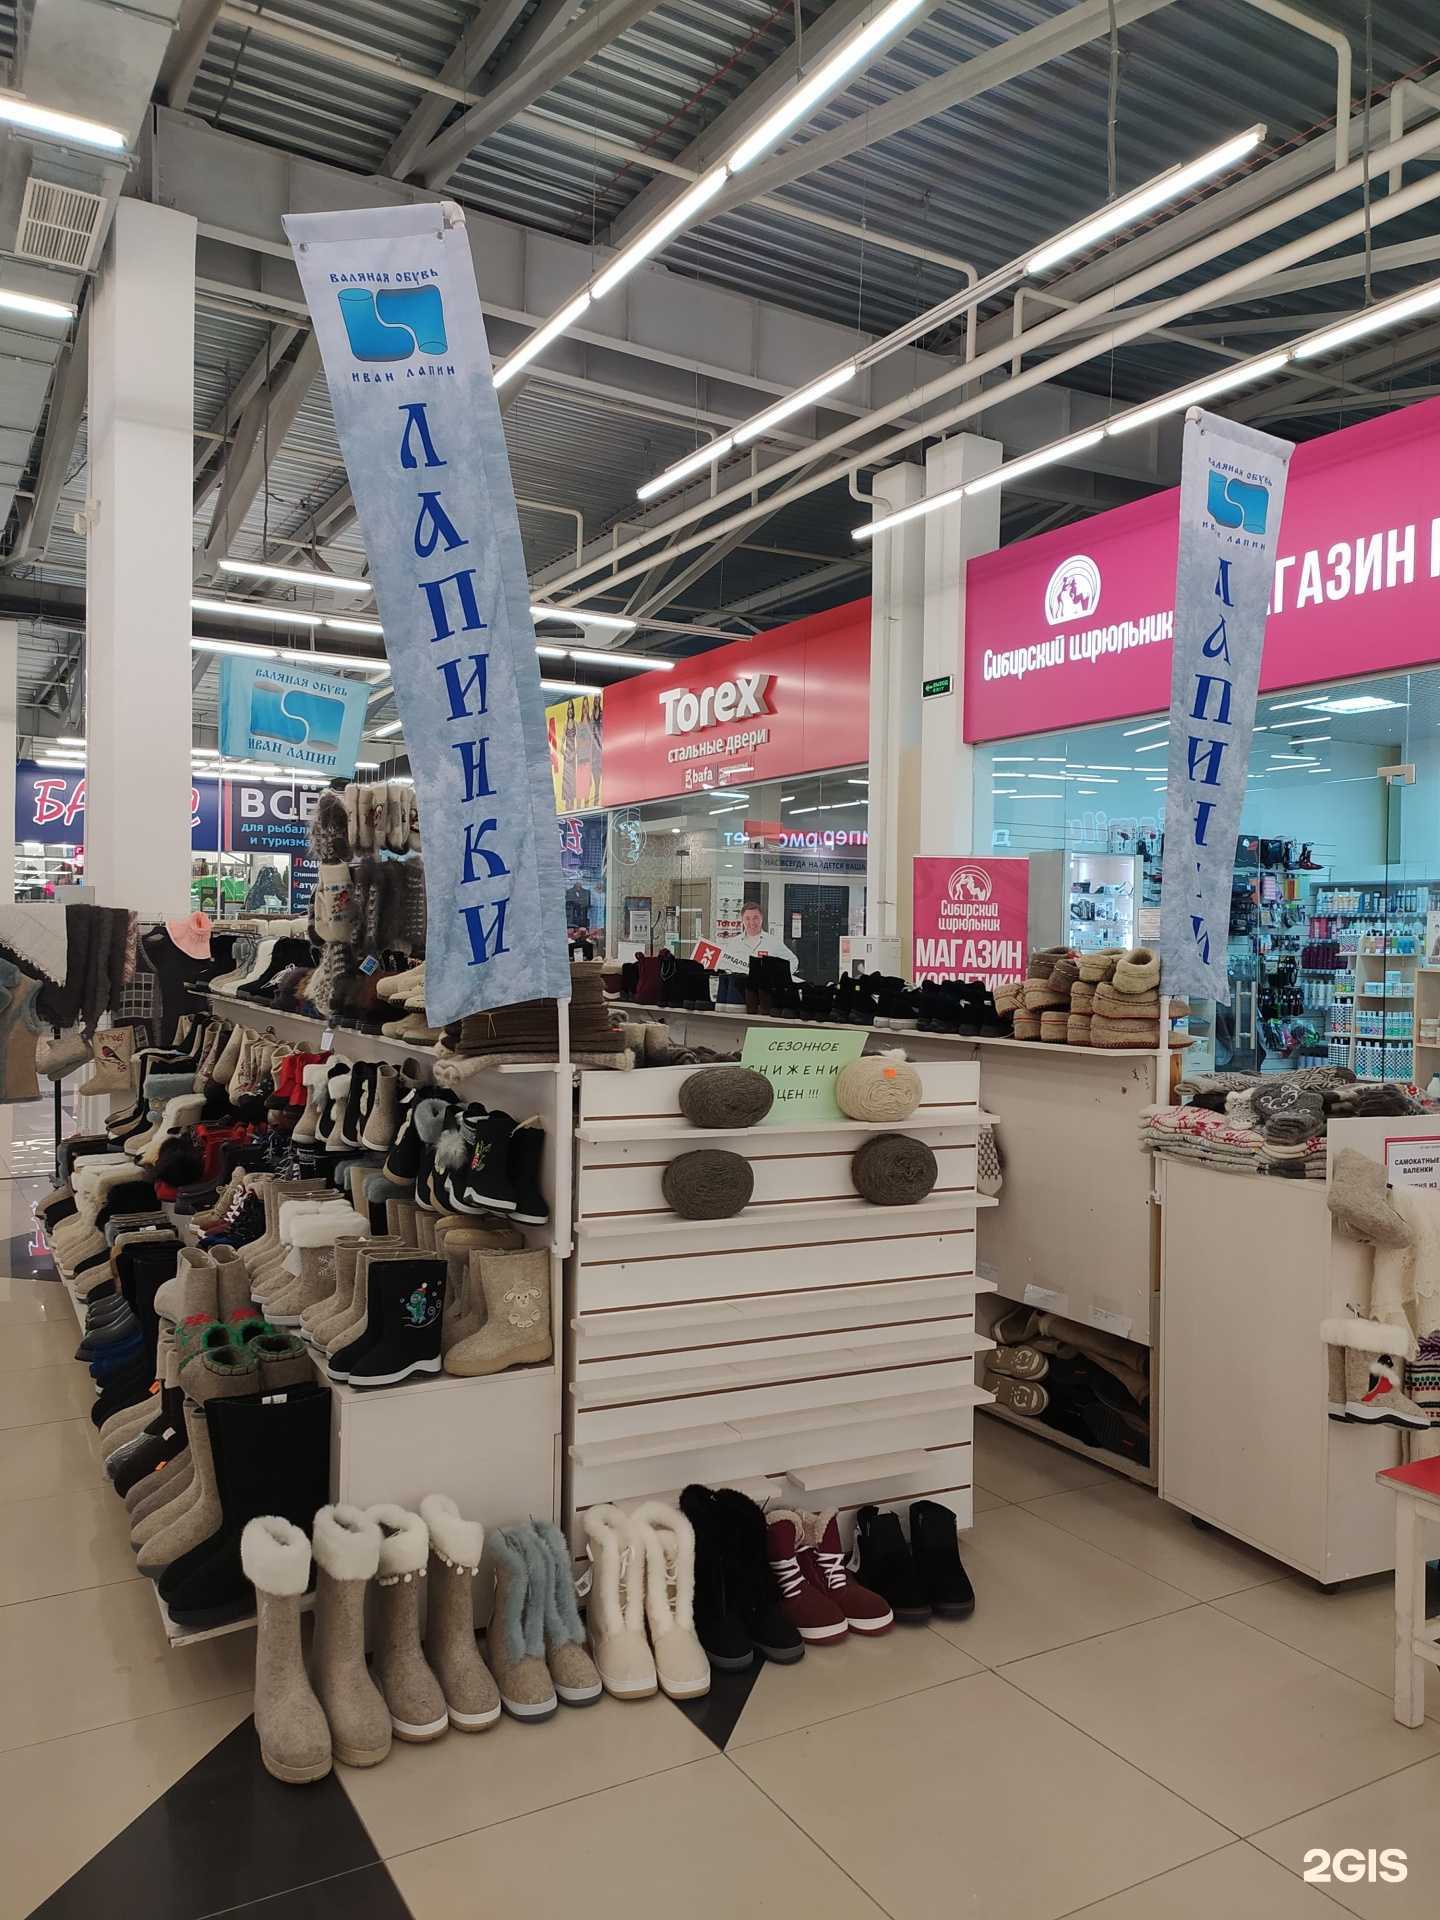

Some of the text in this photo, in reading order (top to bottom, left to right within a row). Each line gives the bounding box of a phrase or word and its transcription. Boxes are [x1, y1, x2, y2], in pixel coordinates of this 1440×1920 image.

[329, 268, 439, 285] ВАЛЯНАЯ ОБУВЬ
[352, 365, 455, 383] ИВАН ЛАПИН
[1266, 524, 1416, 616] ГАЗИН
[983, 610, 1174, 681] Сибирский цирюльник
[398, 403, 511, 966] ЛАПИНКИ
[659, 672, 771, 735] Torex
[247, 738, 337, 766] ИВАН ЛАПИН
[668, 728, 770, 763] стальные двери
[241, 823, 263, 832] для
[250, 837, 257, 845] и
[941, 900, 998, 919] Сибирский
[938, 918, 1000, 933] цирюльник
[916, 938, 1023, 969] МАГАЗИН
[768, 1040, 840, 1052] СЕЗОННОЕ
[777, 1088, 804, 1101] ЦЕН
